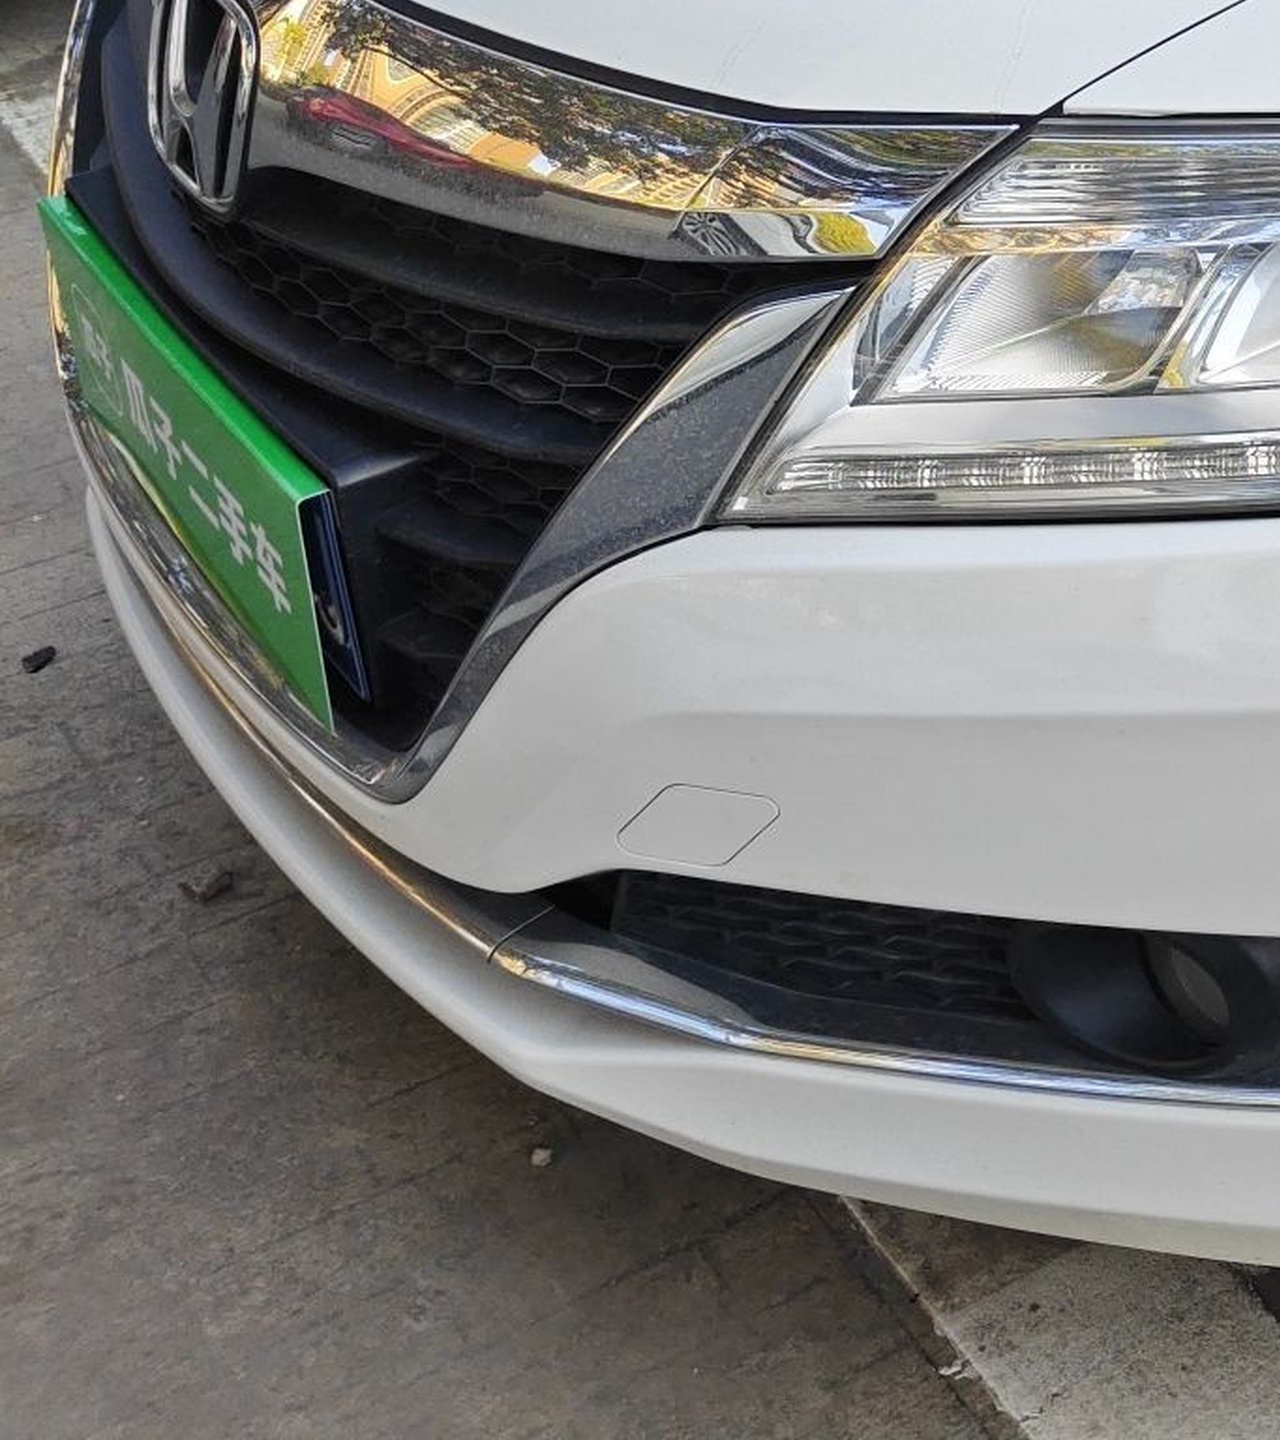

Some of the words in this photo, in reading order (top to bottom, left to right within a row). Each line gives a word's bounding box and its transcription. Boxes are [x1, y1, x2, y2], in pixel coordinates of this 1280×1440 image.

[121, 359, 292, 613] 瓜子二手车
